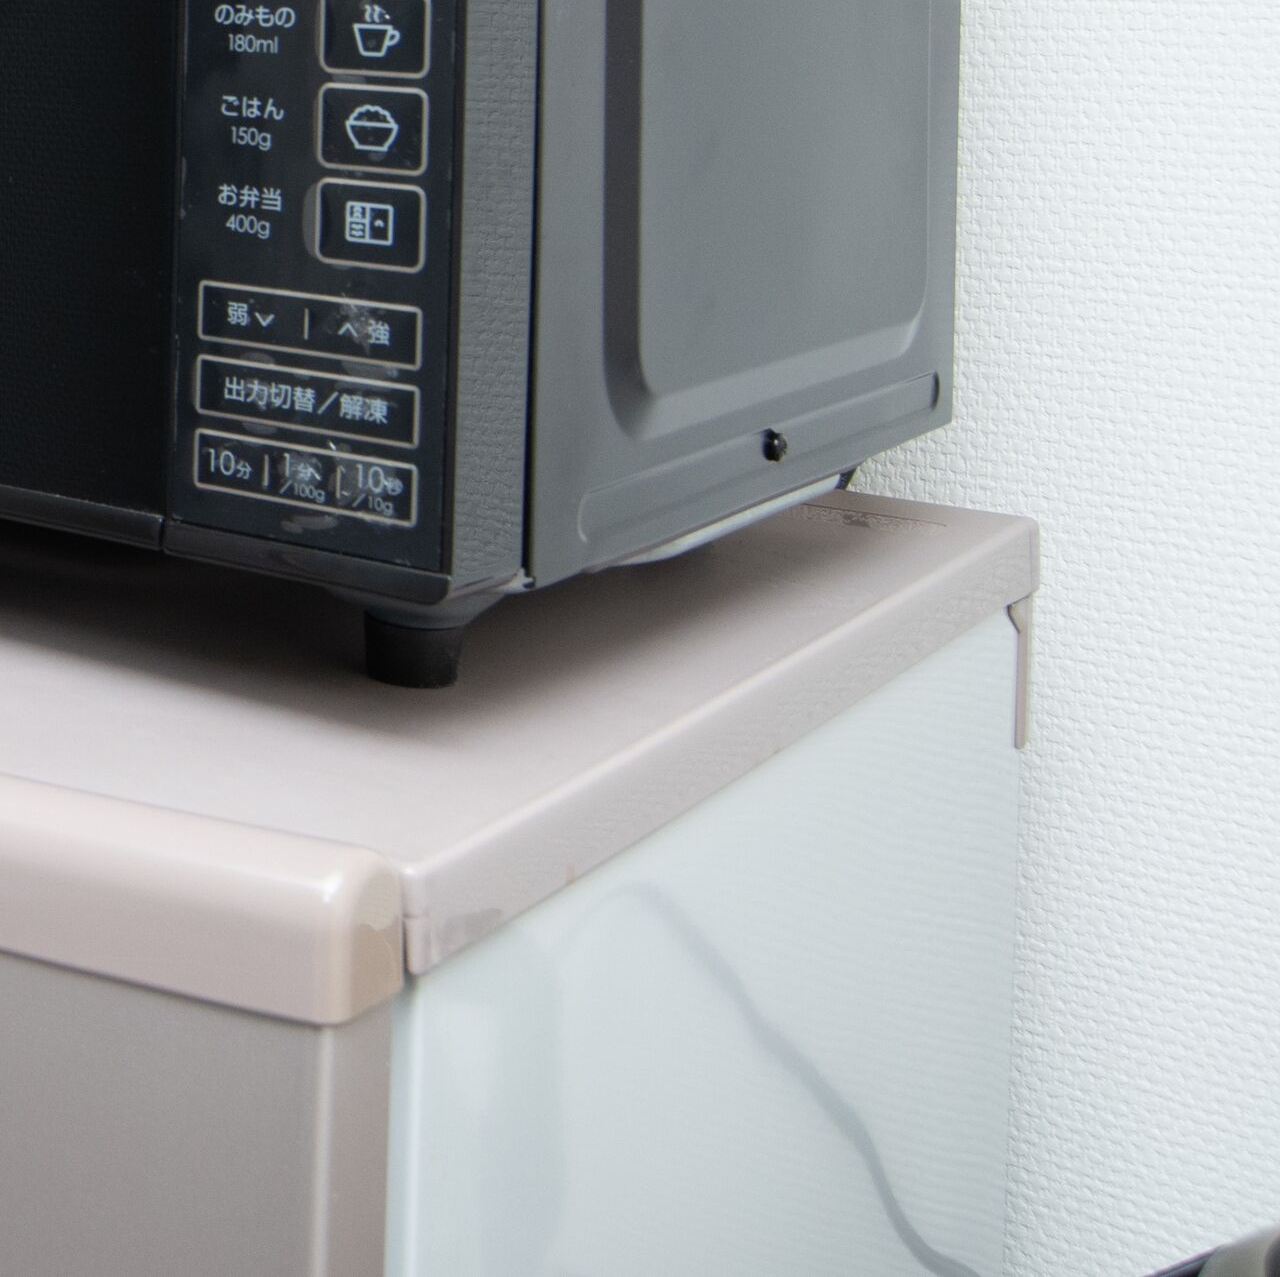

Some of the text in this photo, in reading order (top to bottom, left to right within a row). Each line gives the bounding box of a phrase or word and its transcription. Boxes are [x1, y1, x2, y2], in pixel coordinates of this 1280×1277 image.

[214, 4, 296, 28] のみもの
[228, 33, 278, 54] 180ml
[220, 95, 285, 120] ごはん
[231, 126, 272, 151] 150g
[217, 183, 282, 212] お弁当
[225, 214, 270, 240] 400g
[208, 448, 252, 480] 10分
